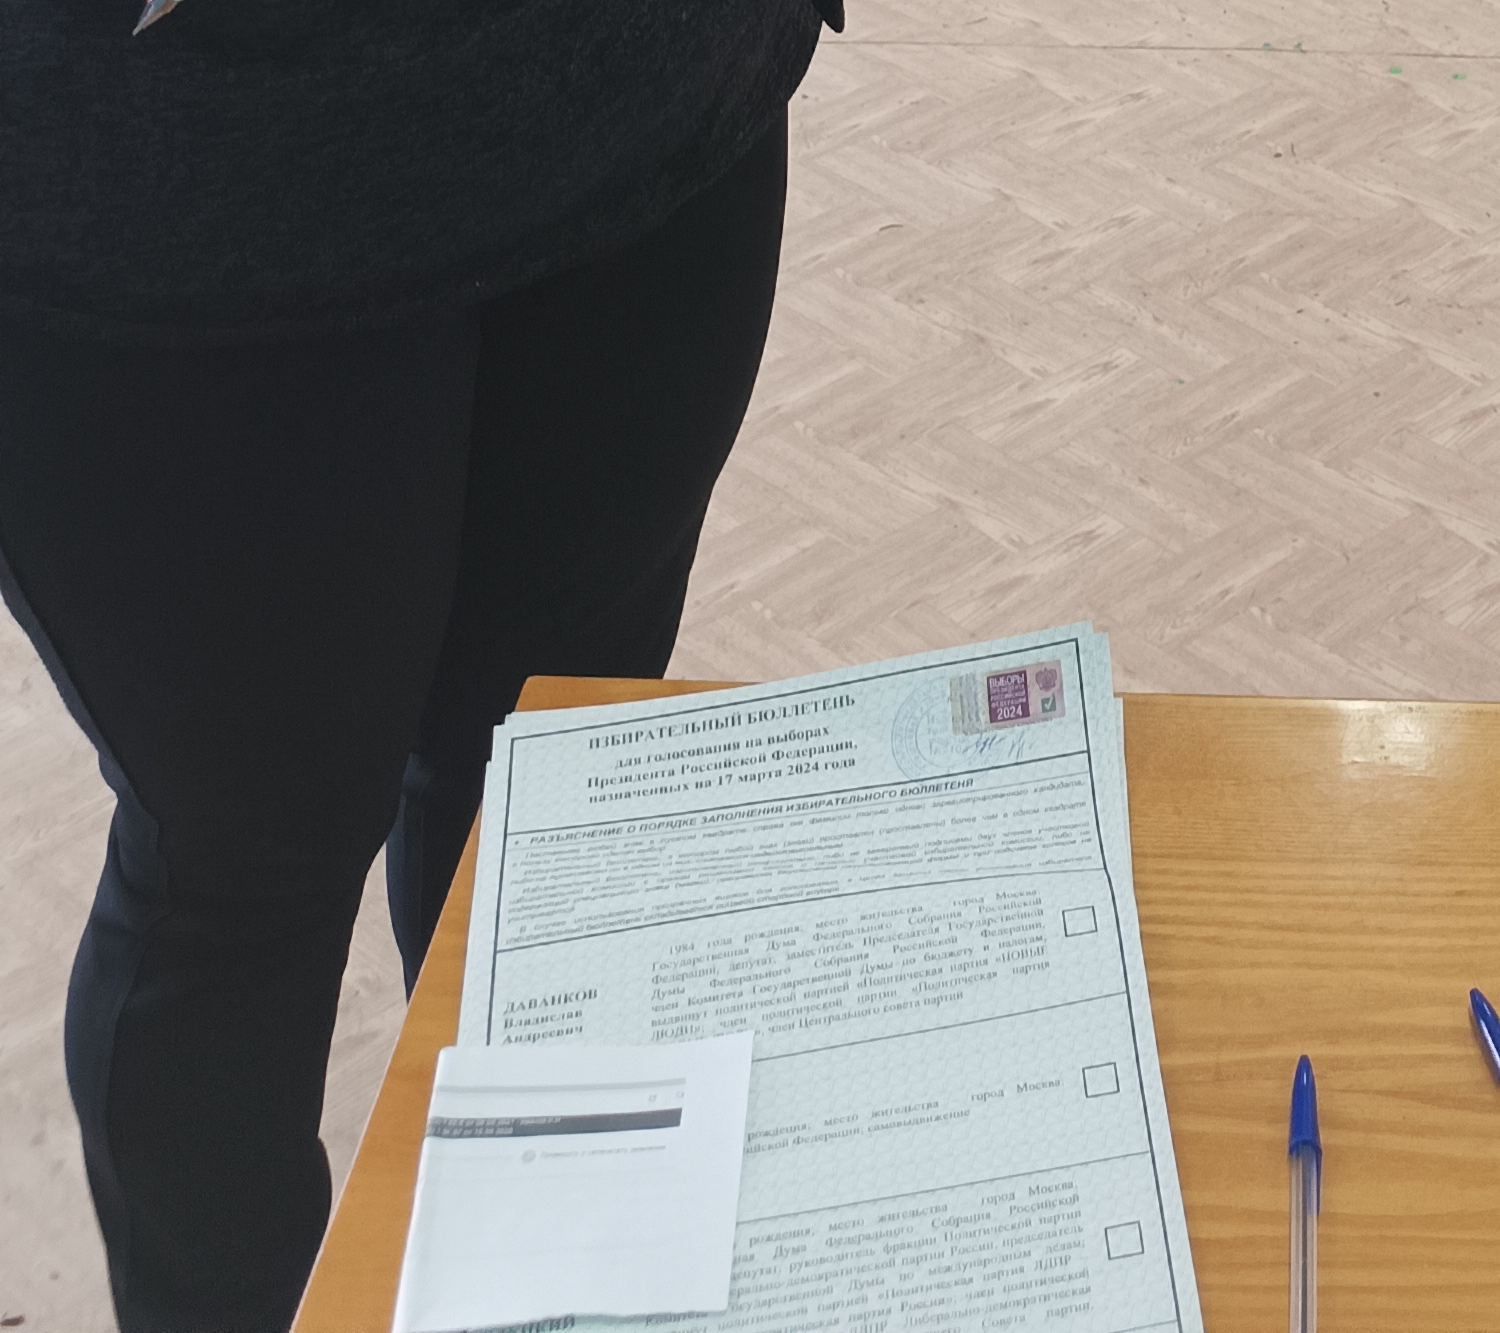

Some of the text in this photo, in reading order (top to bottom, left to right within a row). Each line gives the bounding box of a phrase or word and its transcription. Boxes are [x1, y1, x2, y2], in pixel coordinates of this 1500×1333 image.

[989, 673, 1024, 687] ВЫБОРЫ
[589, 694, 856, 750] ИЗБИРАТЕЛЬНЫЙ БЮЛЛЕТЕНЬ
[997, 705, 1022, 720] 2024
[588, 740, 858, 789] Президента Российской Федерации,
[615, 724, 830, 770] для голосования на выборах
[590, 756, 856, 803] назначенных на 17 марта 2024 года
[530, 779, 974, 844] РАЗЪЯСНЕНИЕ О ПОРЯДКЕ ЗАПОЛНЕНИЯ ИЗБИРАТЕЛЬНОГО БЮЛЛЕТЕНЯ
[670, 943, 695, 955] 1984
[503, 989, 598, 1015] ДАВАНКОВ
[504, 1009, 583, 1030] Владислав
